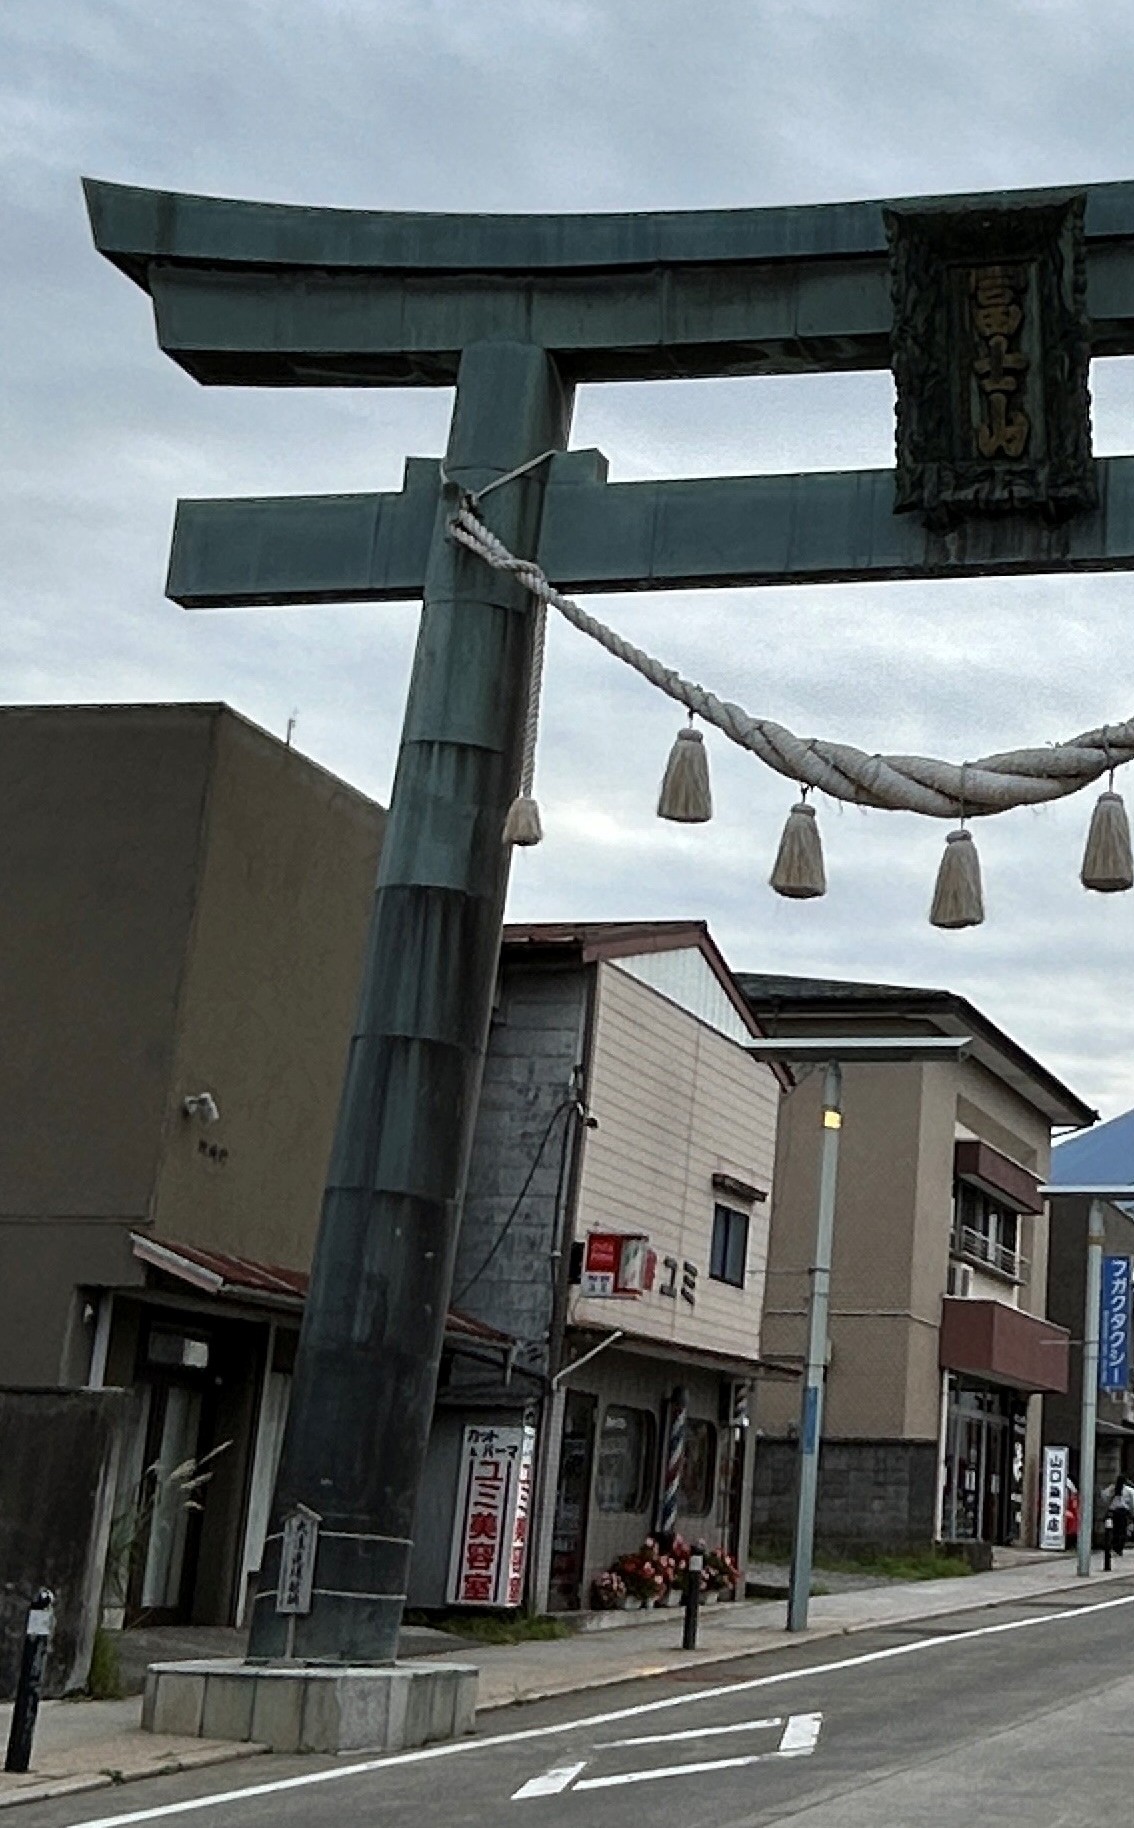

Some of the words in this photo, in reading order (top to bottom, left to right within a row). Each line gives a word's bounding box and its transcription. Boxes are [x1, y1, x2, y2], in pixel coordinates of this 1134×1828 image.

[1108, 1259, 1127, 1383] フガクタクシー
[462, 1460, 503, 1601] ユミ美容室
